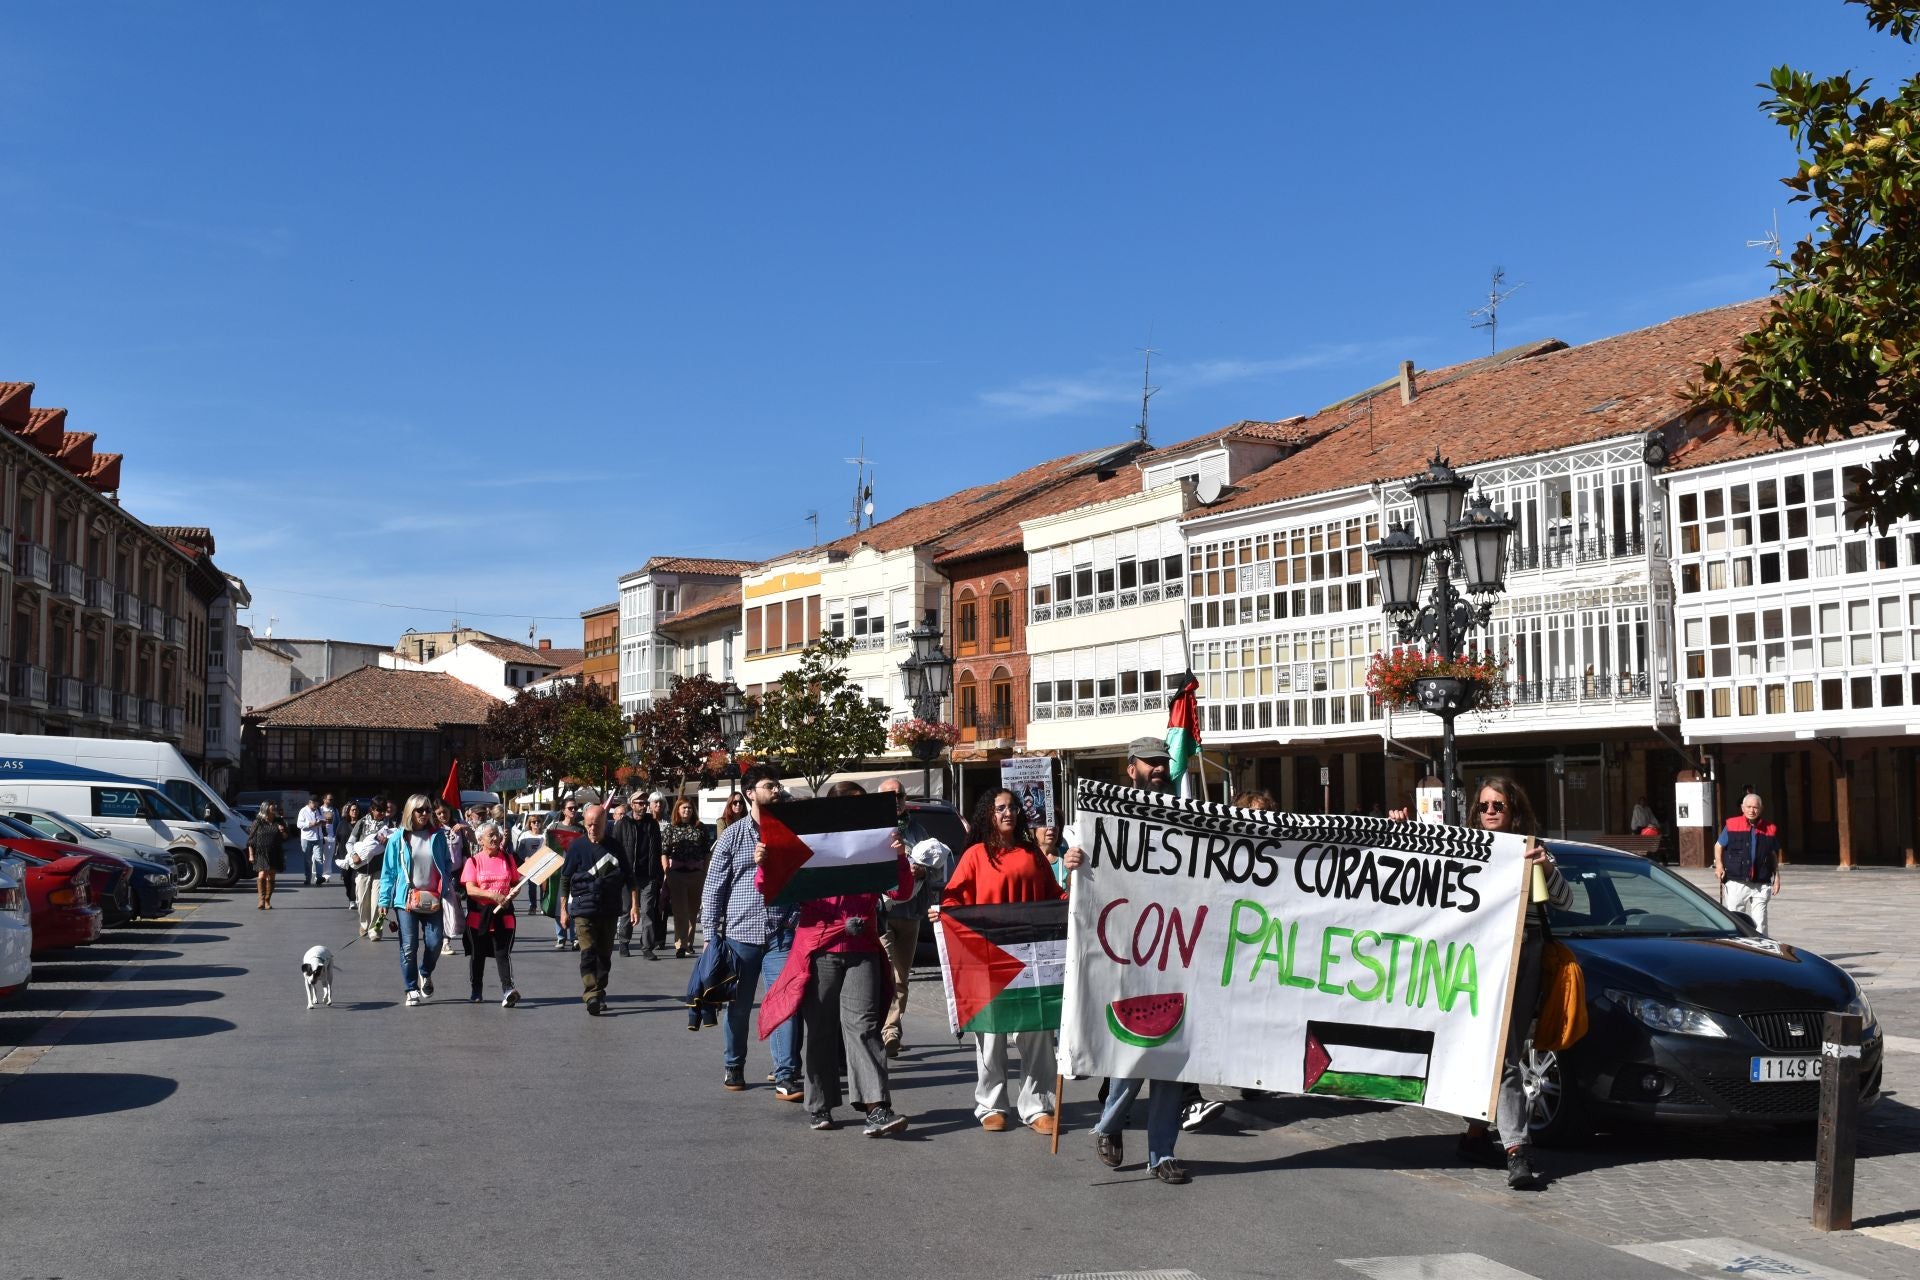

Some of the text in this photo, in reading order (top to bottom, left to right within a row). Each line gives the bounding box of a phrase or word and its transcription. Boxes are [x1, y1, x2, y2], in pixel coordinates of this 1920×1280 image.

[0, 760, 24, 769] ASS
[1091, 817, 1482, 912] NUESTROS CORAZONES
[1097, 898, 1479, 1017] CON PALESTINA
